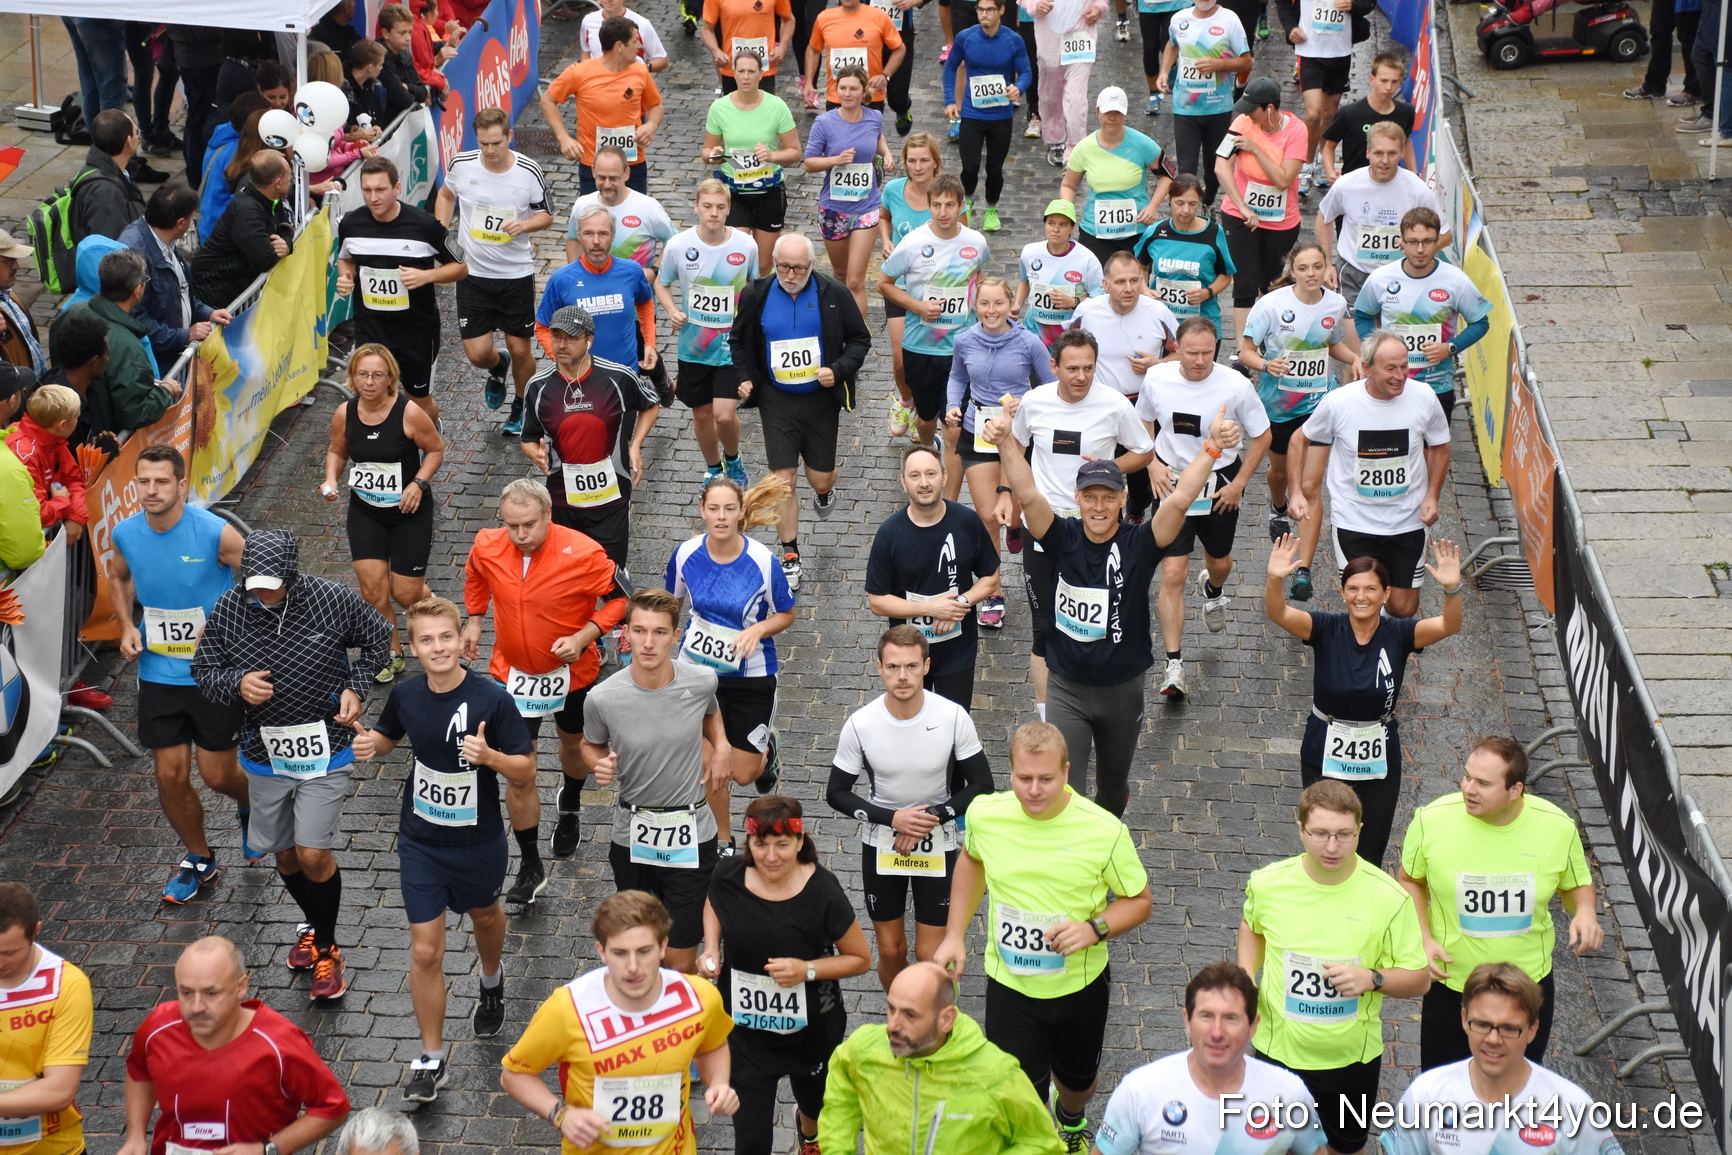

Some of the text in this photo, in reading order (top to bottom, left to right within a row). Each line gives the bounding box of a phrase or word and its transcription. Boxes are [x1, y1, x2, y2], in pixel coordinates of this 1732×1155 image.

[1315, 8, 1344, 23] 3105
[1065, 39, 1091, 53] 3081
[835, 57, 864, 69] 2124
[477, 56, 510, 113] Hervis
[974, 83, 1003, 97] 2033
[600, 135, 634, 149] 2096
[743, 154, 761, 169] 58
[834, 172, 869, 187] 2469
[1248, 192, 1282, 207] 2661
[484, 215, 504, 232] 67
[1099, 209, 1133, 224] 2105
[1159, 257, 1200, 272] HUBER
[1370, 253, 1389, 261] Georg
[369, 278, 398, 295] 240
[372, 297, 397, 305] Michael
[576, 293, 624, 308] HUBER
[1160, 287, 1193, 305] 253
[1430, 290, 1450, 299] Hervis
[693, 294, 728, 313] 2291
[700, 314, 720, 323] Tobias
[1038, 311, 1065, 320] Christine
[781, 349, 812, 369] 260
[1288, 358, 1325, 376] 2080
[789, 371, 806, 379] Ernst
[1296, 380, 1313, 388] Julia
[353, 469, 398, 492] 2344
[575, 471, 608, 491] 609
[1360, 467, 1406, 486] 2808
[1373, 488, 1392, 497] Alois
[1059, 592, 1103, 624] 2502
[158, 621, 197, 642] 152
[1066, 620, 1089, 636] Jochen
[167, 644, 192, 654] Armin
[690, 630, 738, 664] 2633
[700, 658, 720, 669] Jana
[513, 675, 565, 698] 2782
[1566, 592, 1619, 785] MINI
[526, 701, 549, 711] Erwin
[269, 734, 324, 759] 2385
[1331, 737, 1382, 760] 2436
[284, 761, 316, 773] Andreas
[1341, 764, 1371, 774] Verena
[418, 778, 472, 807] 2667
[428, 807, 456, 820] Stefan
[636, 823, 692, 847] 2778
[656, 852, 671, 861] Nic
[893, 857, 929, 868] Andreas
[1464, 889, 1526, 914] 3011
[1014, 955, 1041, 967] Manu
[1290, 969, 1345, 998] 239
[739, 987, 799, 1014] 3044
[1298, 1002, 1344, 1015] Christian
[9, 1007, 56, 1032] BÖGL
[738, 1013, 796, 1030] SIGRID
[594, 1022, 705, 1074] MAX BÖGL
[611, 1093, 665, 1123] 288
[618, 1128, 653, 1139] Moritz
[1160, 1129, 1186, 1140] PARTL
[1435, 1132, 1460, 1142] PARTL
[1524, 1128, 1553, 1141] Hervis
